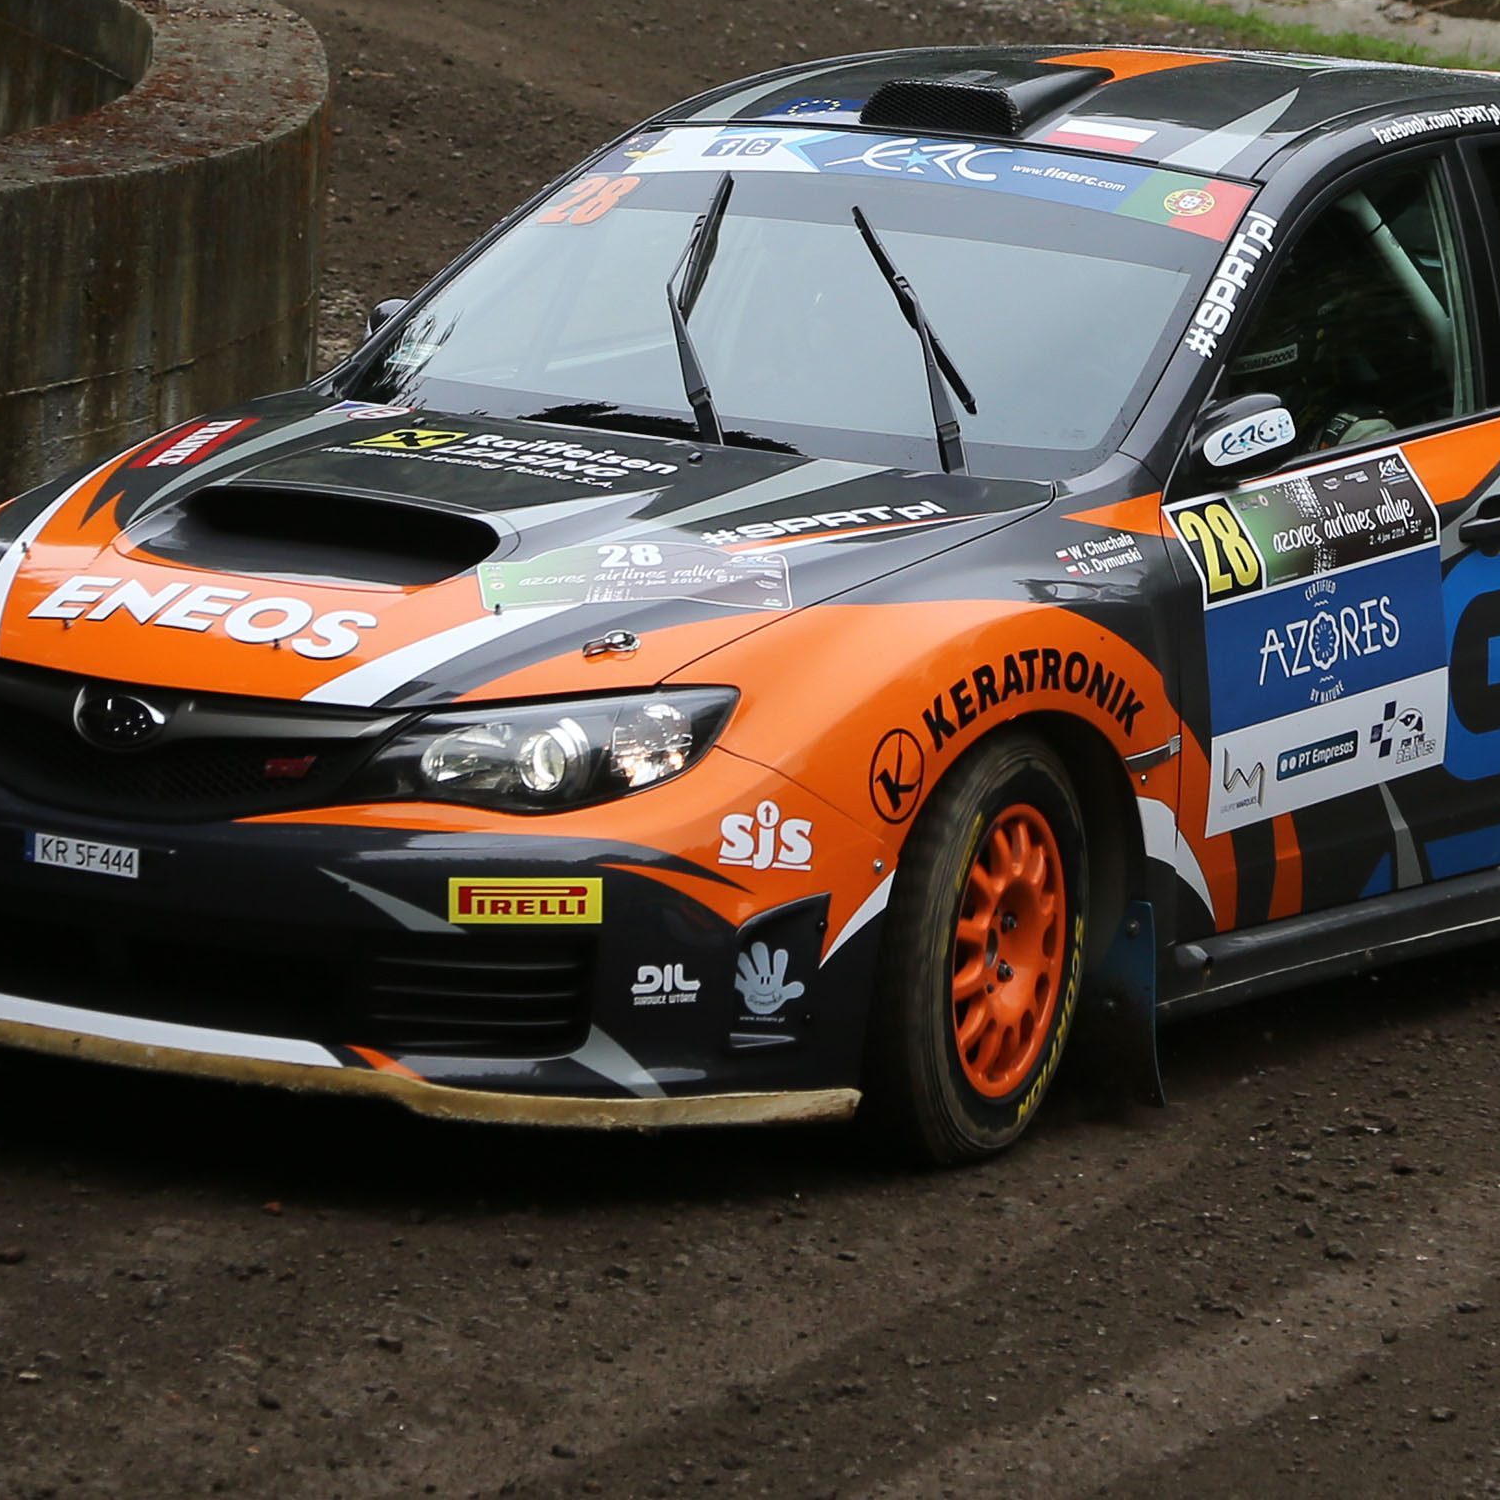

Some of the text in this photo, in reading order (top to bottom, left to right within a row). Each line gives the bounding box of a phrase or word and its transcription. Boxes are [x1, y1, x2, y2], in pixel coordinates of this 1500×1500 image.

[1011, 162, 1127, 193] www.fiaerc.com
[536, 176, 640, 225] 28
[1185, 209, 1278, 359] #SPRTpl
[430, 444, 630, 479] LEASING
[462, 433, 679, 476] Raiffeisen
[503, 463, 571, 482] Polska
[573, 476, 613, 490] S.A.
[700, 500, 949, 547] #SPRTpl
[1273, 486, 1415, 554] azores airlines rallye
[597, 544, 663, 569] 28
[1067, 544, 1087, 560] W.
[1077, 546, 1143, 575] D. Dymurski
[1177, 503, 1260, 595] 28
[517, 573, 586, 588] azores
[28, 574, 379, 660] ENEOS
[1258, 595, 1400, 686] AZORES
[921, 647, 1146, 754] KERATRONIK
[1298, 740, 1355, 770] PT Empresas
[39, 836, 135, 876] KR 5F444
[457, 886, 589, 916] PIRELLI
[631, 963, 701, 994] DIL
[1017, 914, 1084, 1124] SCORPION
